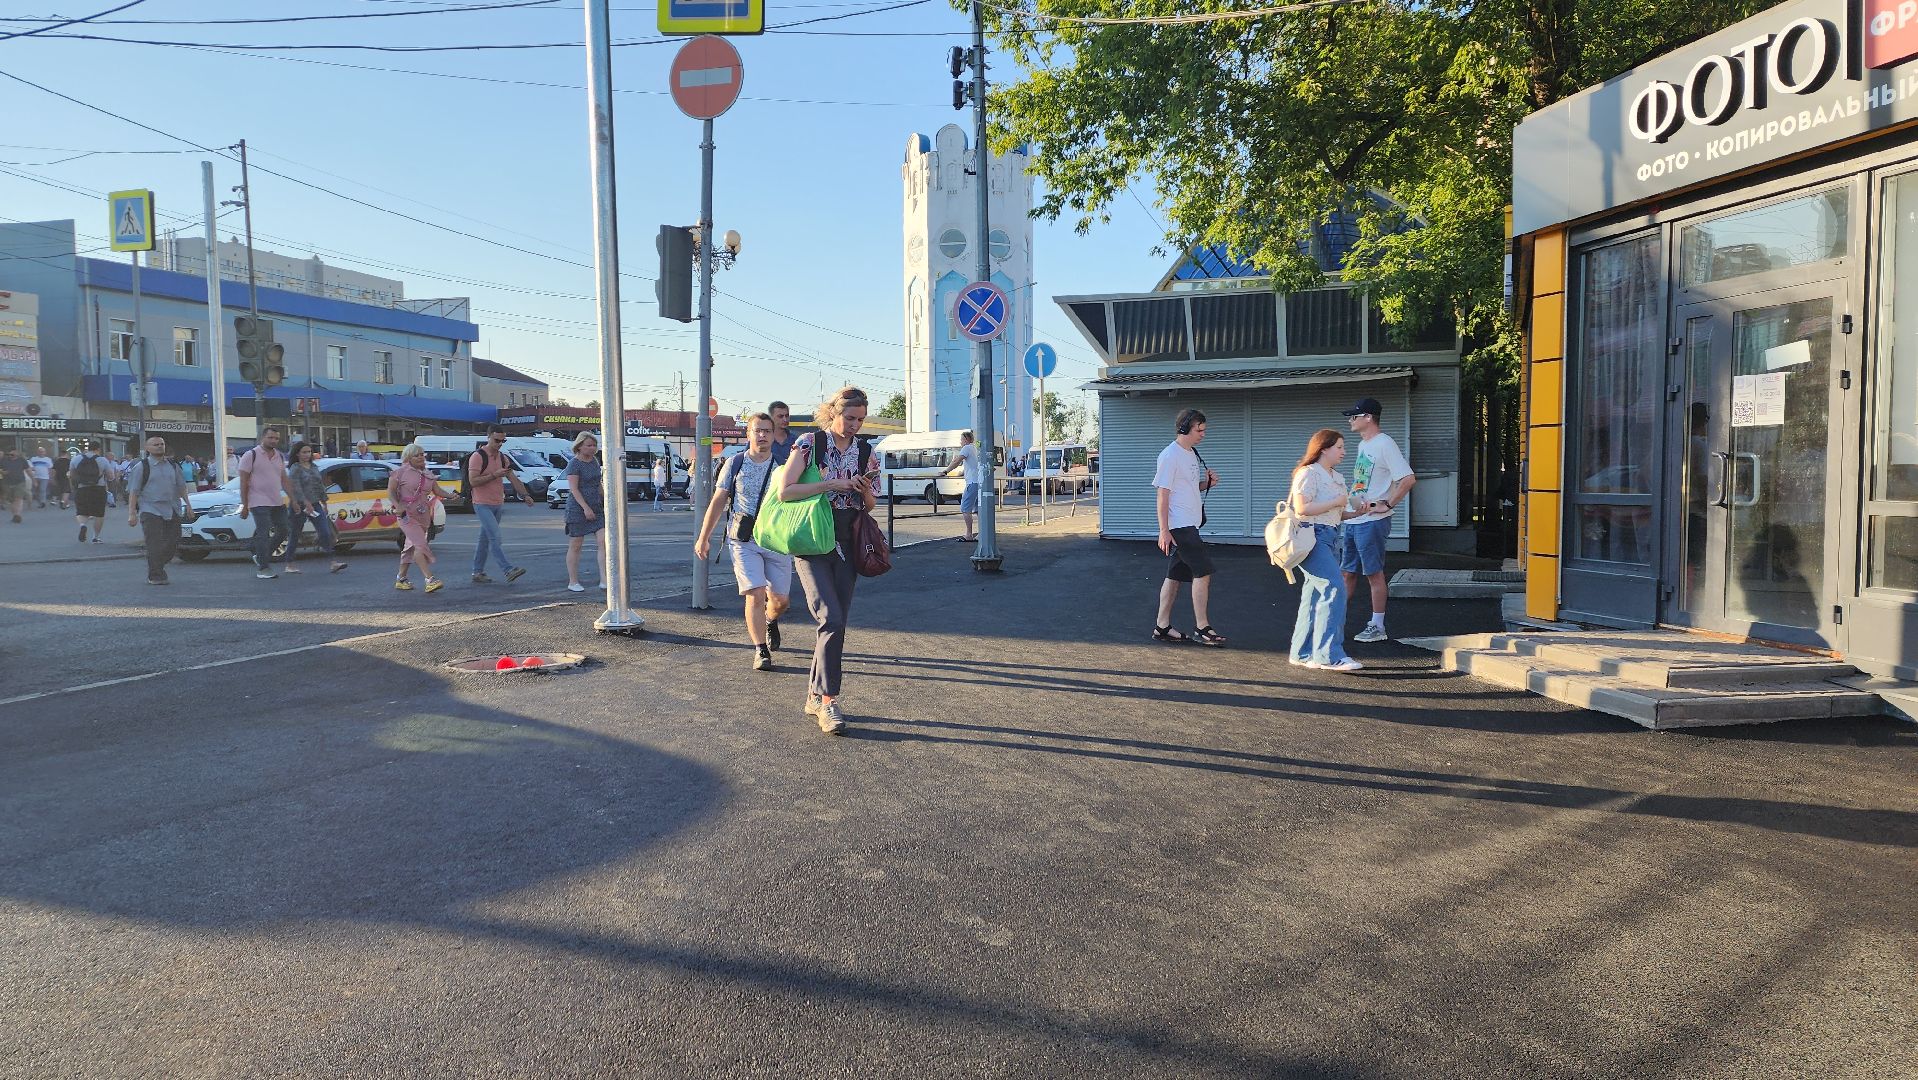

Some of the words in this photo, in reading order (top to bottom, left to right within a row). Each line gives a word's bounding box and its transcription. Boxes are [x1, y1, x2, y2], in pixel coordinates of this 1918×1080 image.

[1870, 0, 1918, 36] ФР
[1629, 17, 1832, 143] ФОТО
[1636, 151, 1690, 182] ФОТО
[1706, 70, 1918, 161] КОПИРОВАЛЬНЫЙ
[578, 416, 601, 424] РЕМО
[627, 426, 650, 435] cofix
